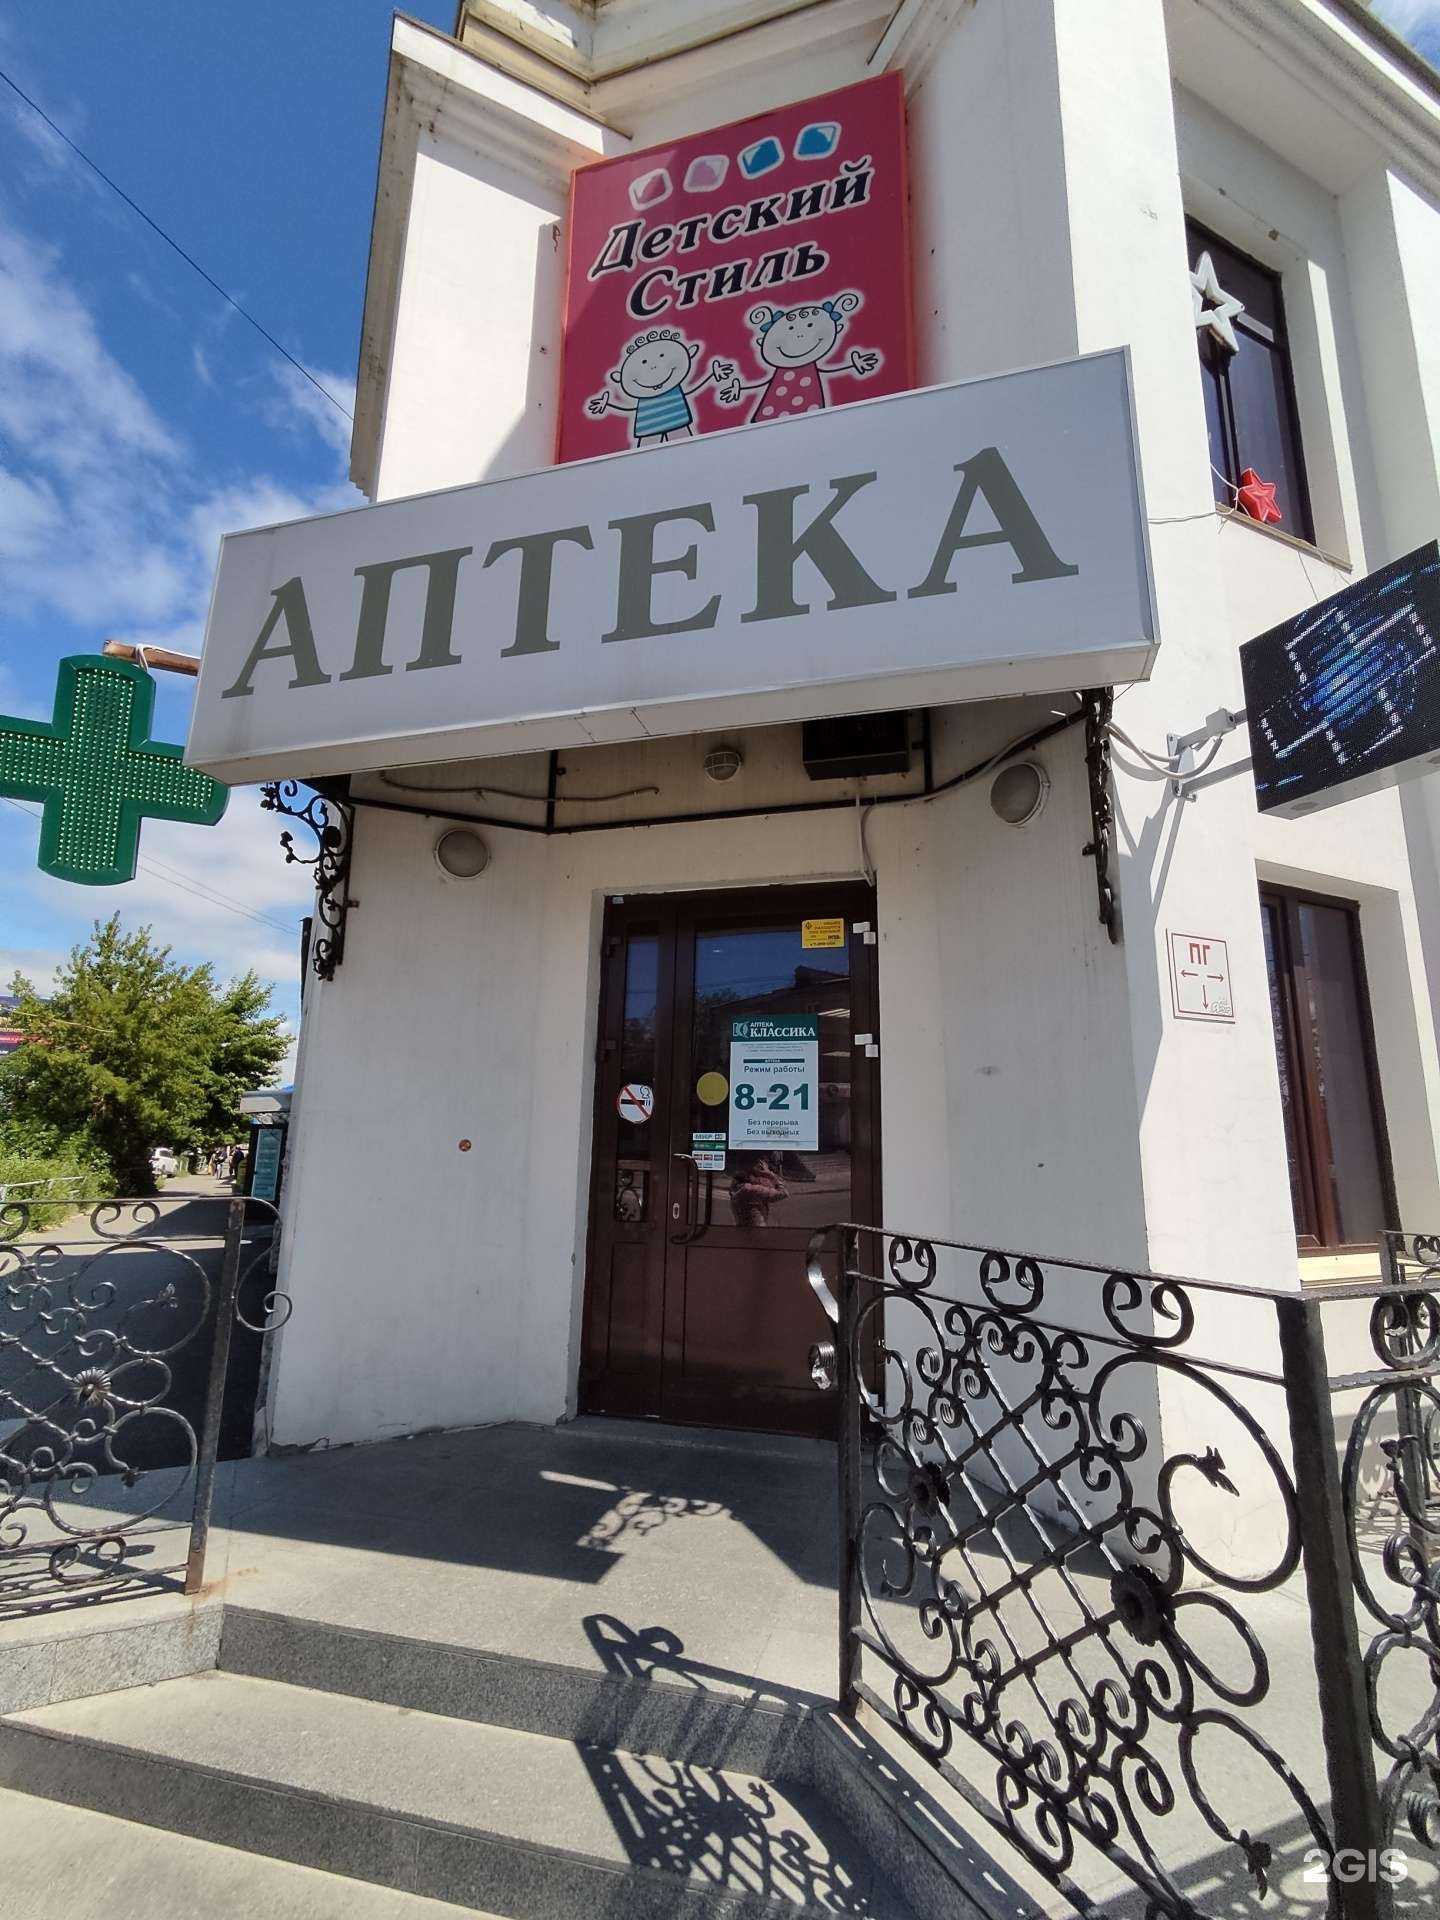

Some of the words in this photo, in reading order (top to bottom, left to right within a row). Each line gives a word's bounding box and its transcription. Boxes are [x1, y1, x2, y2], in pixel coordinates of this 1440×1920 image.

[589, 156, 873, 280] Детский
[628, 241, 827, 318] Стиль
[221, 446, 1079, 699] АПТЕКА
[1189, 942, 1210, 965] ПГ
[750, 1027, 816, 1038] КЛАССИКА
[744, 1065, 771, 1073] Режим
[773, 1065, 805, 1075] работы
[734, 1083, 809, 1111] 8-21
[747, 1118, 761, 1126] Без
